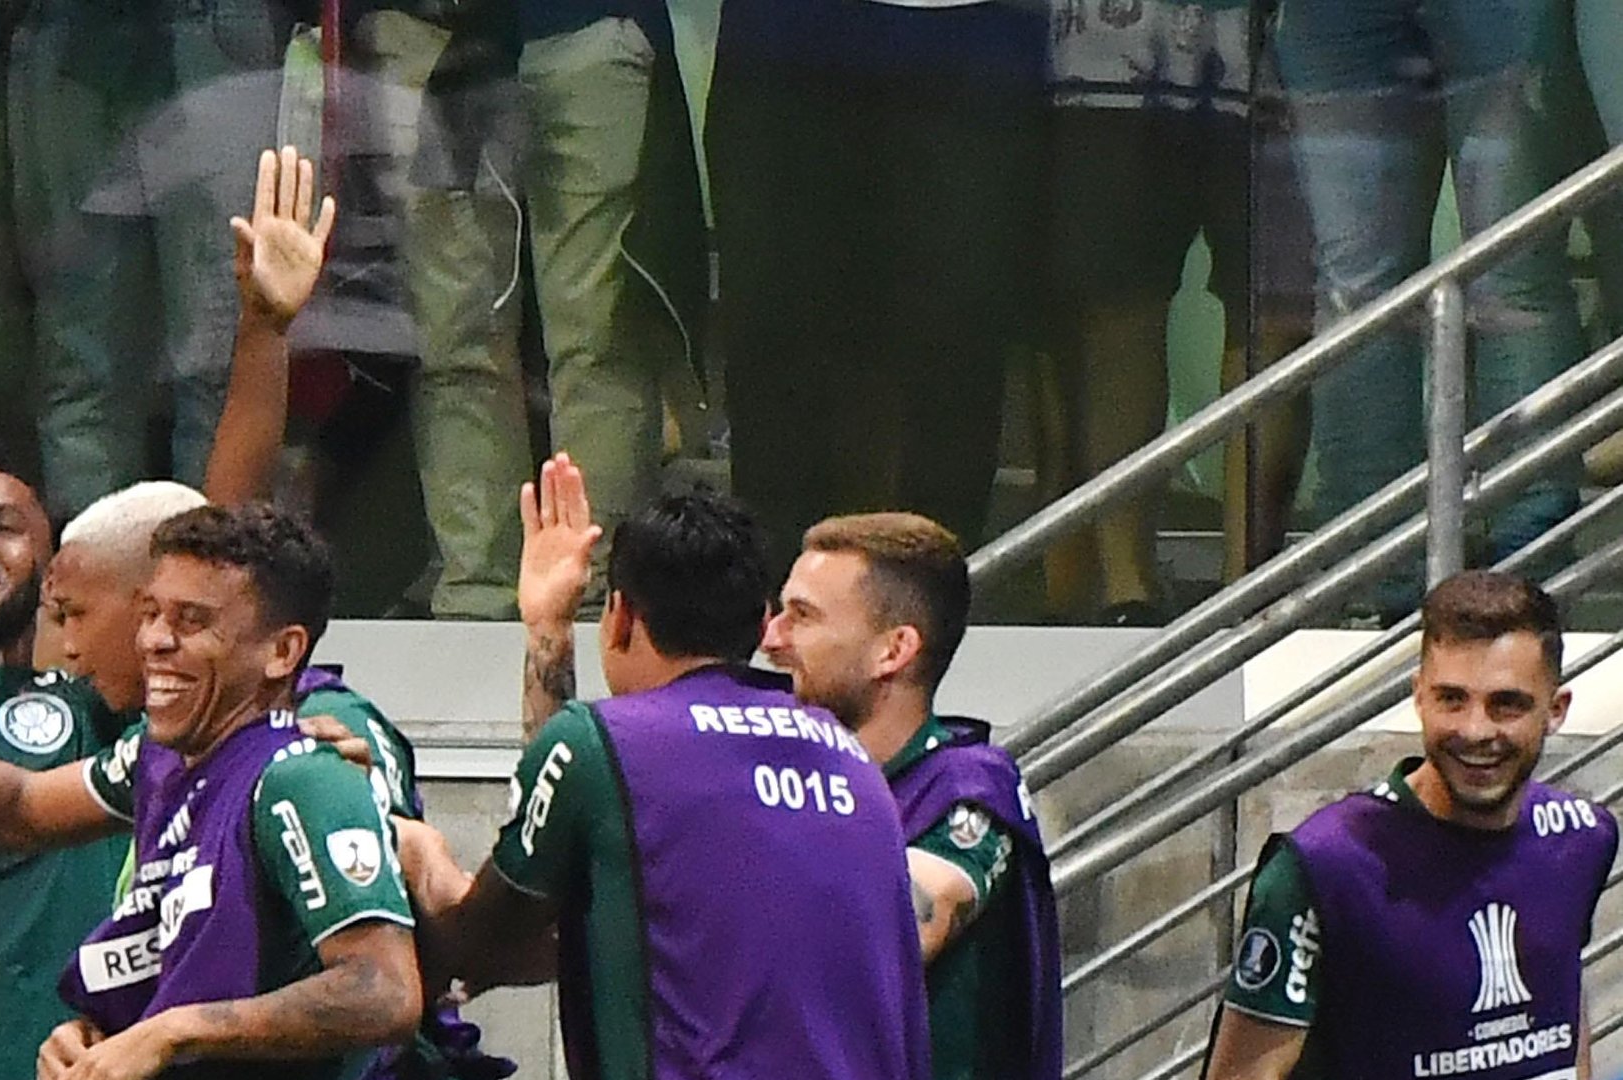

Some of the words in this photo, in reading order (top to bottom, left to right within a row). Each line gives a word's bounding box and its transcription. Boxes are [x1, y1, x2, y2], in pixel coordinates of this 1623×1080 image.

[689, 704, 870, 764] RESERVAS
[754, 764, 856, 816] 0015
[1532, 799, 1598, 837] 0018
[1413, 1023, 1573, 1078] LIBERTADORES
